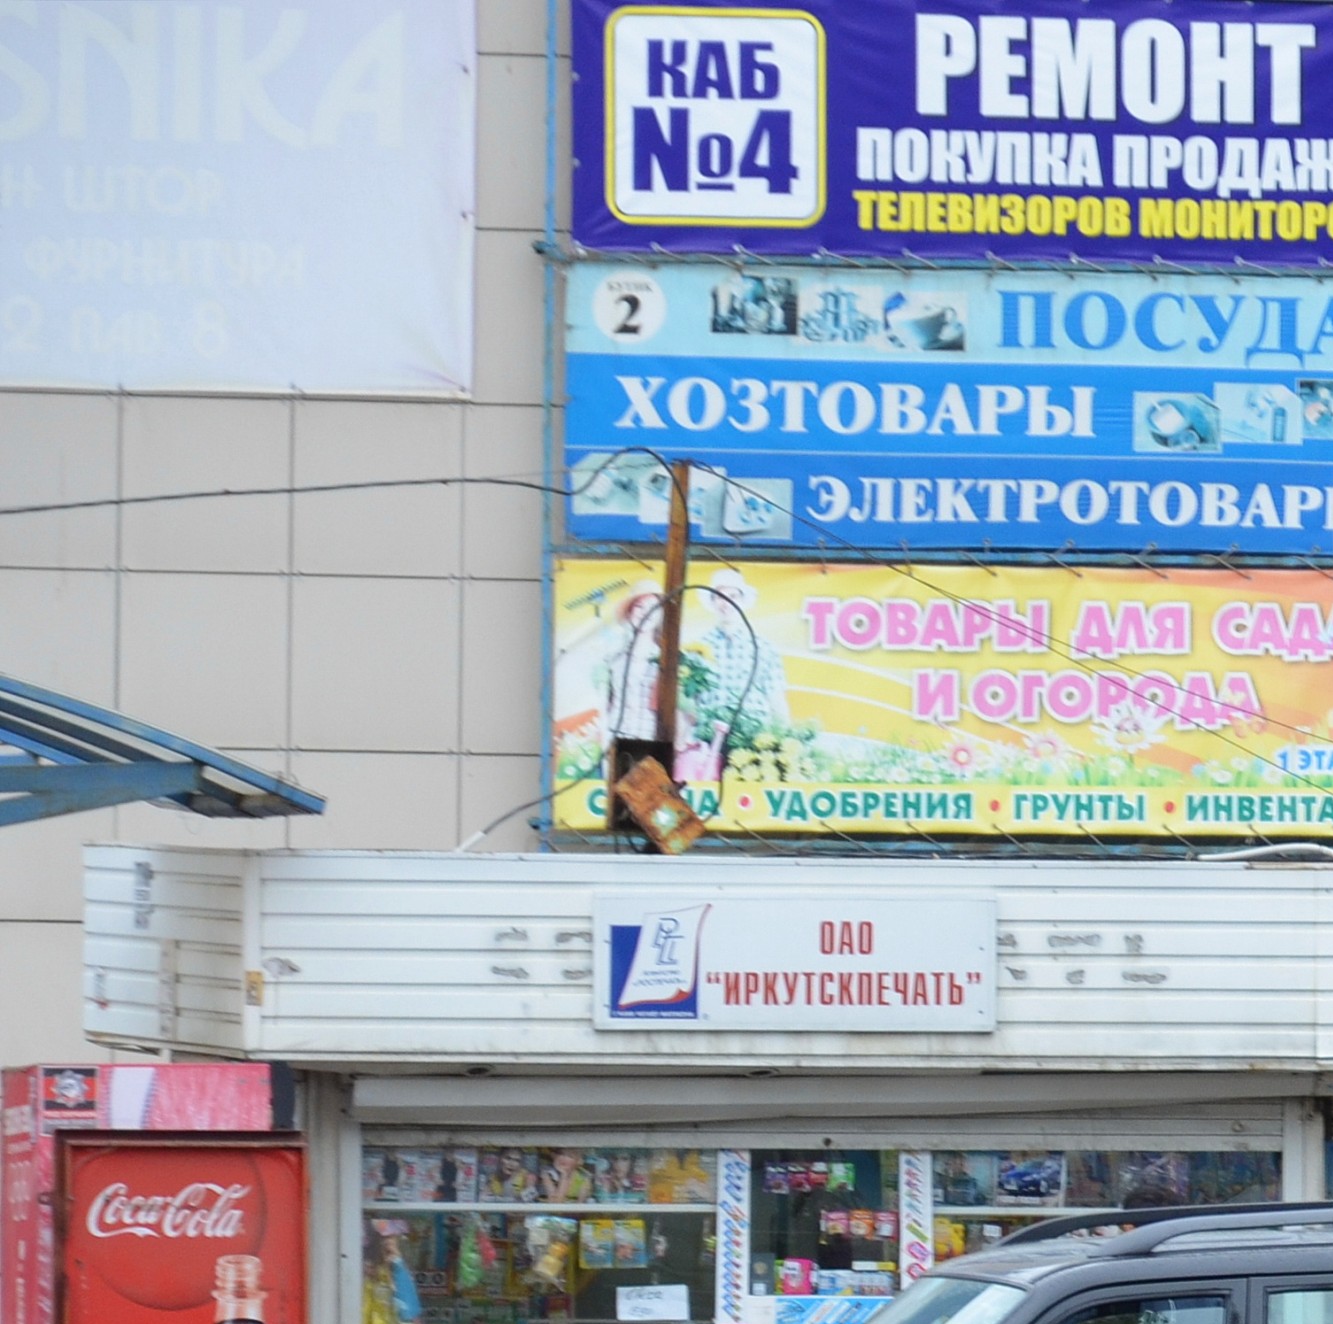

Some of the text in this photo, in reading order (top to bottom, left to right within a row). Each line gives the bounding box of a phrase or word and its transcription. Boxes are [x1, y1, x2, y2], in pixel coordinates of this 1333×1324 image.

[647, 40, 781, 100] КАБ
[915, 12, 1316, 127] РЕМОНТ
[633, 107, 799, 194] №4
[857, 127, 1103, 189] ПОКУПКА
[853, 189, 1133, 238] ТЕЛЕВИЗОРОВ
[613, 294, 641, 334] 2
[614, 375, 1096, 440] ХОЗТОВАРЫ
[804, 596, 1049, 655] ТОВАРЫ
[1073, 600, 1191, 661] ДЛЯ
[910, 668, 1265, 727] И ОГОРОДА
[1274, 747, 1289, 771] 1
[763, 789, 973, 823] УДОБРЕНИЯ
[1012, 791, 1146, 824] ГРУНТЫ
[818, 920, 874, 956] ОАО
